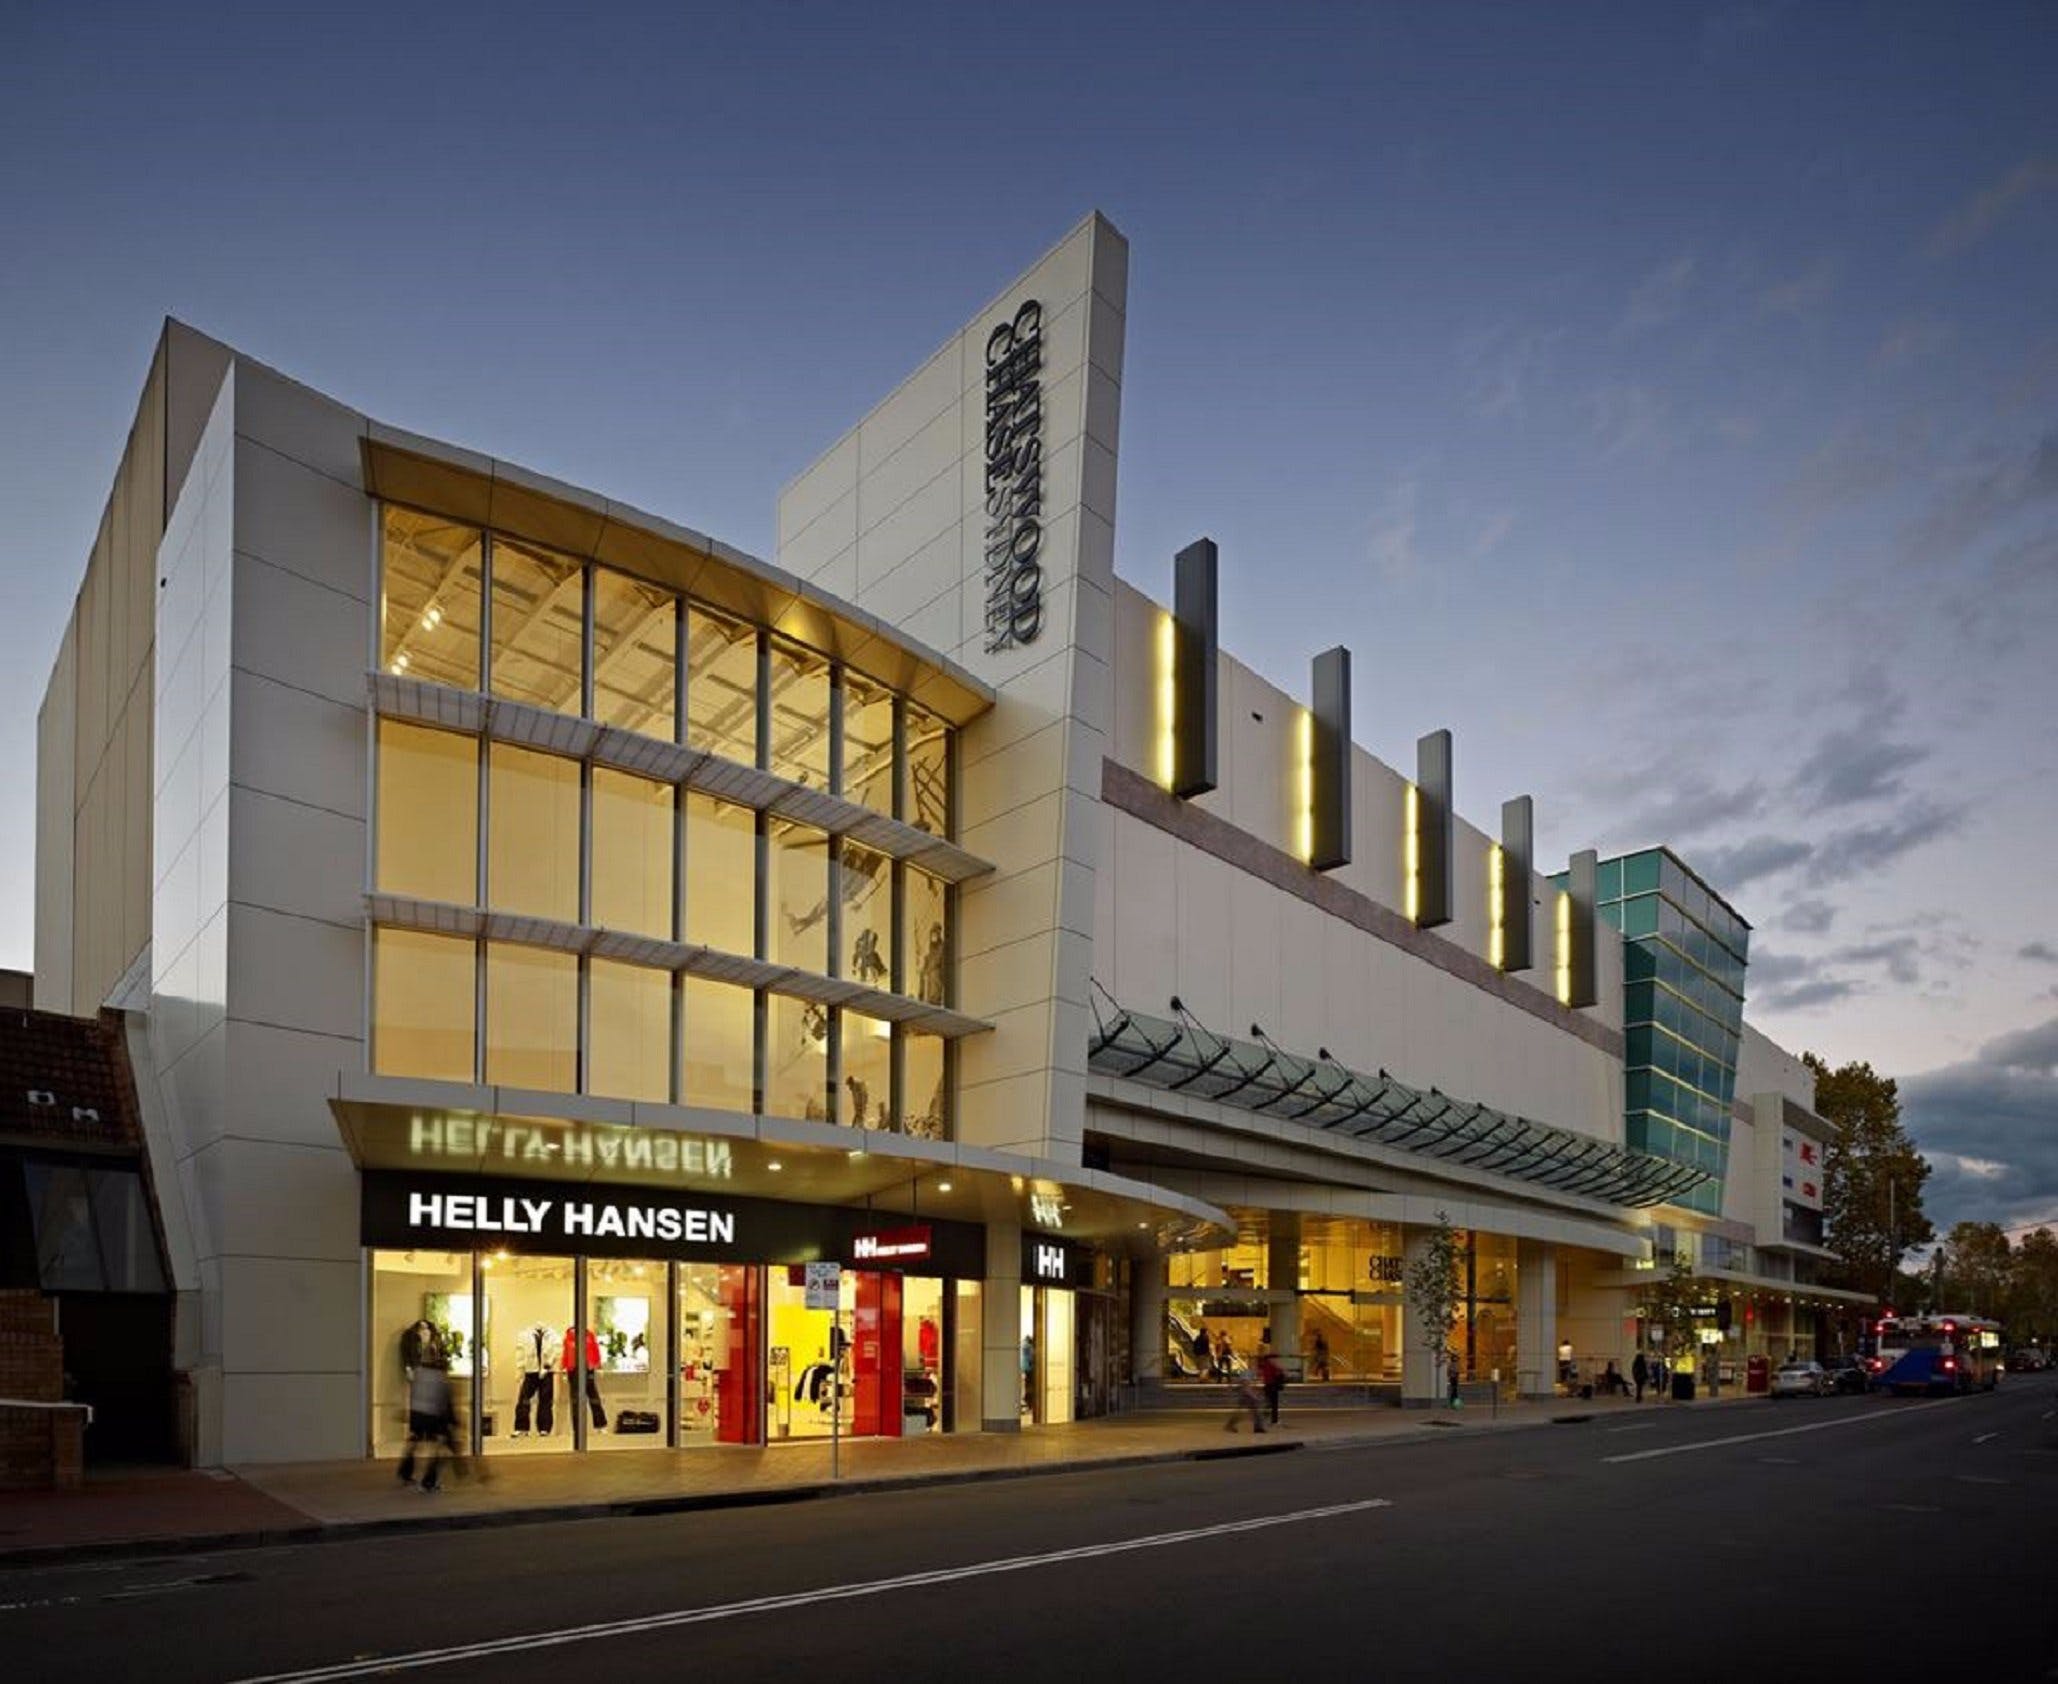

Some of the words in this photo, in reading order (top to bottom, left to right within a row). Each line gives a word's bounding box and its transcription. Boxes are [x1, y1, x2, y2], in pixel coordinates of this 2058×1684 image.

[985, 321, 1015, 493] CHASE
[1009, 299, 1042, 646] CHATSWOOD
[408, 1192, 552, 1233] HELLY
[563, 1201, 735, 1243] HANSEN
[1037, 1244, 1064, 1279] HH
